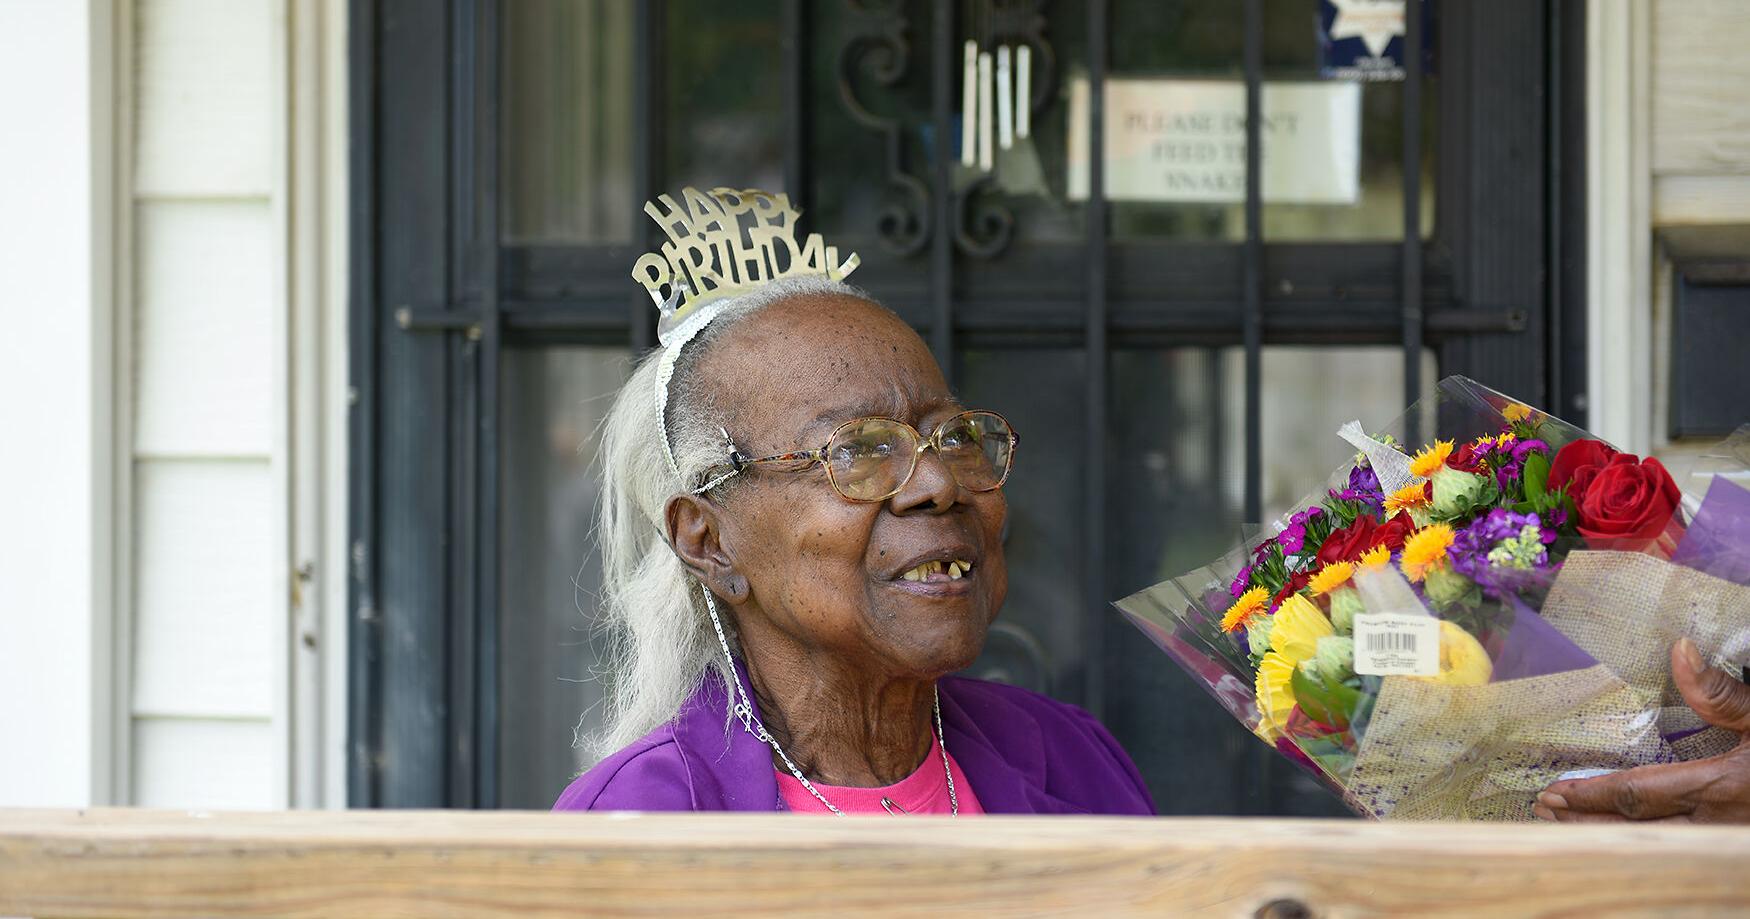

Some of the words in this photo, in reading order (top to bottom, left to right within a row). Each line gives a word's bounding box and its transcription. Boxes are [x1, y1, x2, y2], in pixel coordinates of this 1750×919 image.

[1123, 111, 1216, 135] PLEASE
[1151, 139, 1219, 162] FEED
[644, 186, 803, 249] HAPPY
[632, 232, 861, 310] BIRTHDAY
